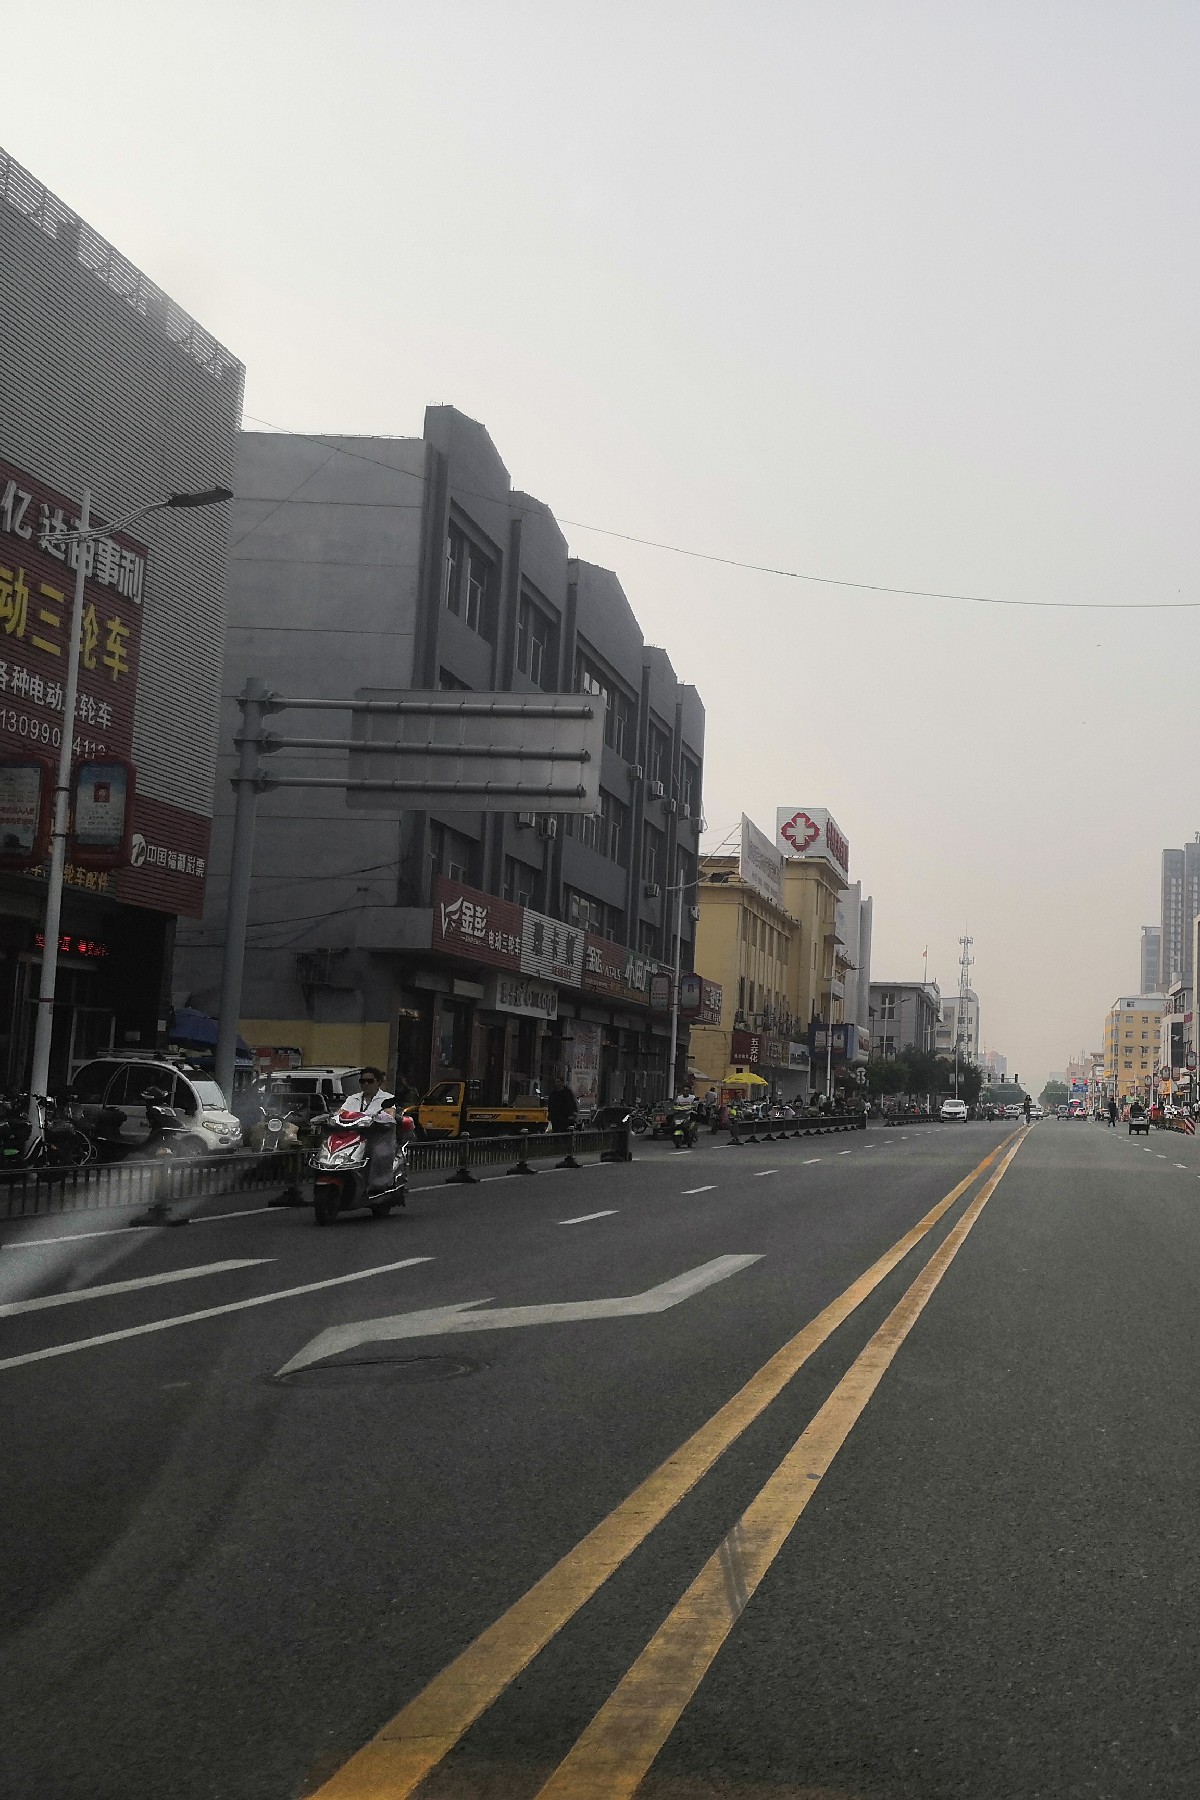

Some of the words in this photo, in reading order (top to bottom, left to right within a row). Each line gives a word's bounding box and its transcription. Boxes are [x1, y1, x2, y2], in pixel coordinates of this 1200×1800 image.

[147, 845, 205, 877] 中国福利彩票
[749, 1037, 760, 1063] 五交化
